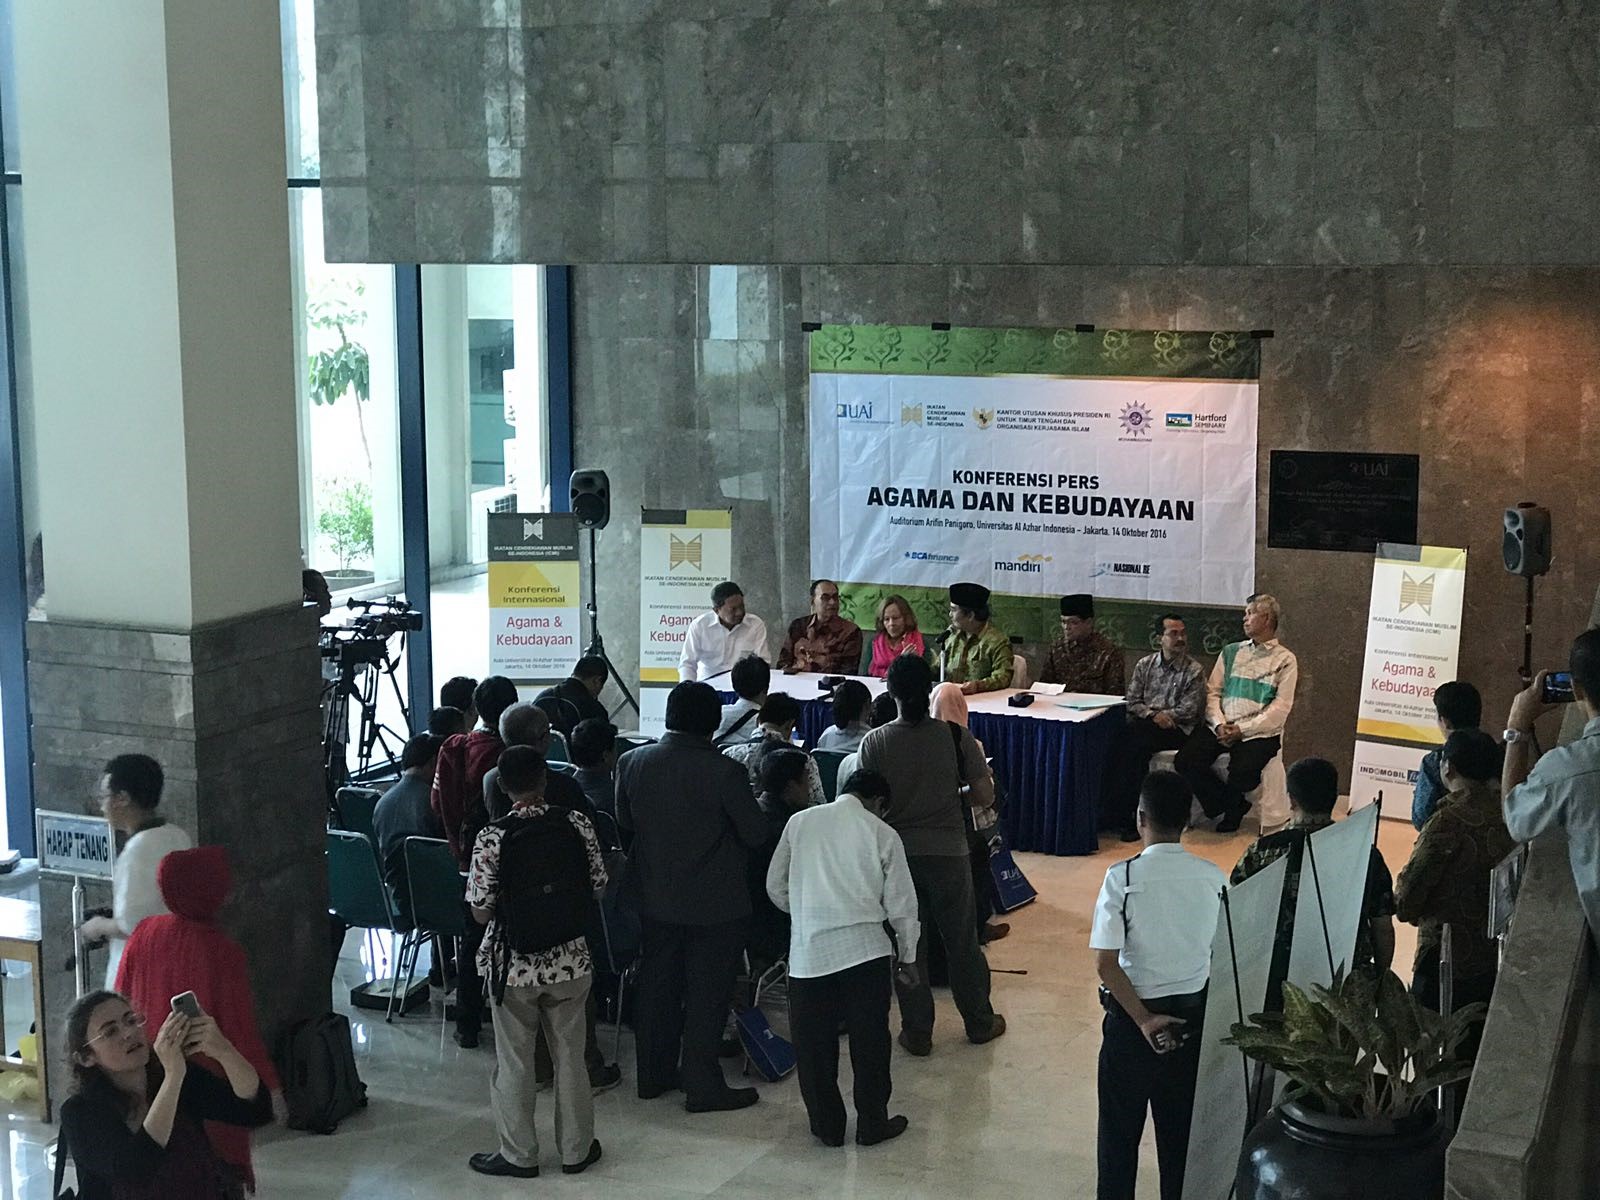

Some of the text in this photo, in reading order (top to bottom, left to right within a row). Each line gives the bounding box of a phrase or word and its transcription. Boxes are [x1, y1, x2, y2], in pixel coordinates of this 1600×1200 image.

[1194, 414, 1226, 422] Hartford
[952, 470, 1099, 490] KONFERENSI PERS
[867, 486, 1194, 521] AGAMA DAN KEBUDAYAAN
[890, 516, 924, 526] Auditorium
[926, 517, 943, 527] Arifin
[977, 520, 1013, 531] Universitas
[1015, 522, 1021, 531] Al
[1023, 523, 1041, 532] Azhar
[1043, 524, 1075, 534] Indonesia
[1112, 527, 1120, 536] 14
[1122, 528, 1148, 538] Oktober
[1150, 529, 1167, 538] 2016
[994, 561, 1040, 572] mandiri
[1114, 563, 1141, 574] NASIONAL
[506, 616, 562, 629] Agama &
[660, 614, 696, 627] Agam
[1393, 618, 1433, 627] CENDEKIAWAN
[496, 634, 573, 647] Kebudayaan
[650, 631, 686, 642] Kebud
[1374, 648, 1448, 661] Konferensi Internasional
[1383, 661, 1436, 679] Agama &
[1371, 678, 1437, 698] Kebudayaa
[1360, 766, 1406, 778] INDOMOBIL
[46, 829, 108, 862] HARAP TENANG
